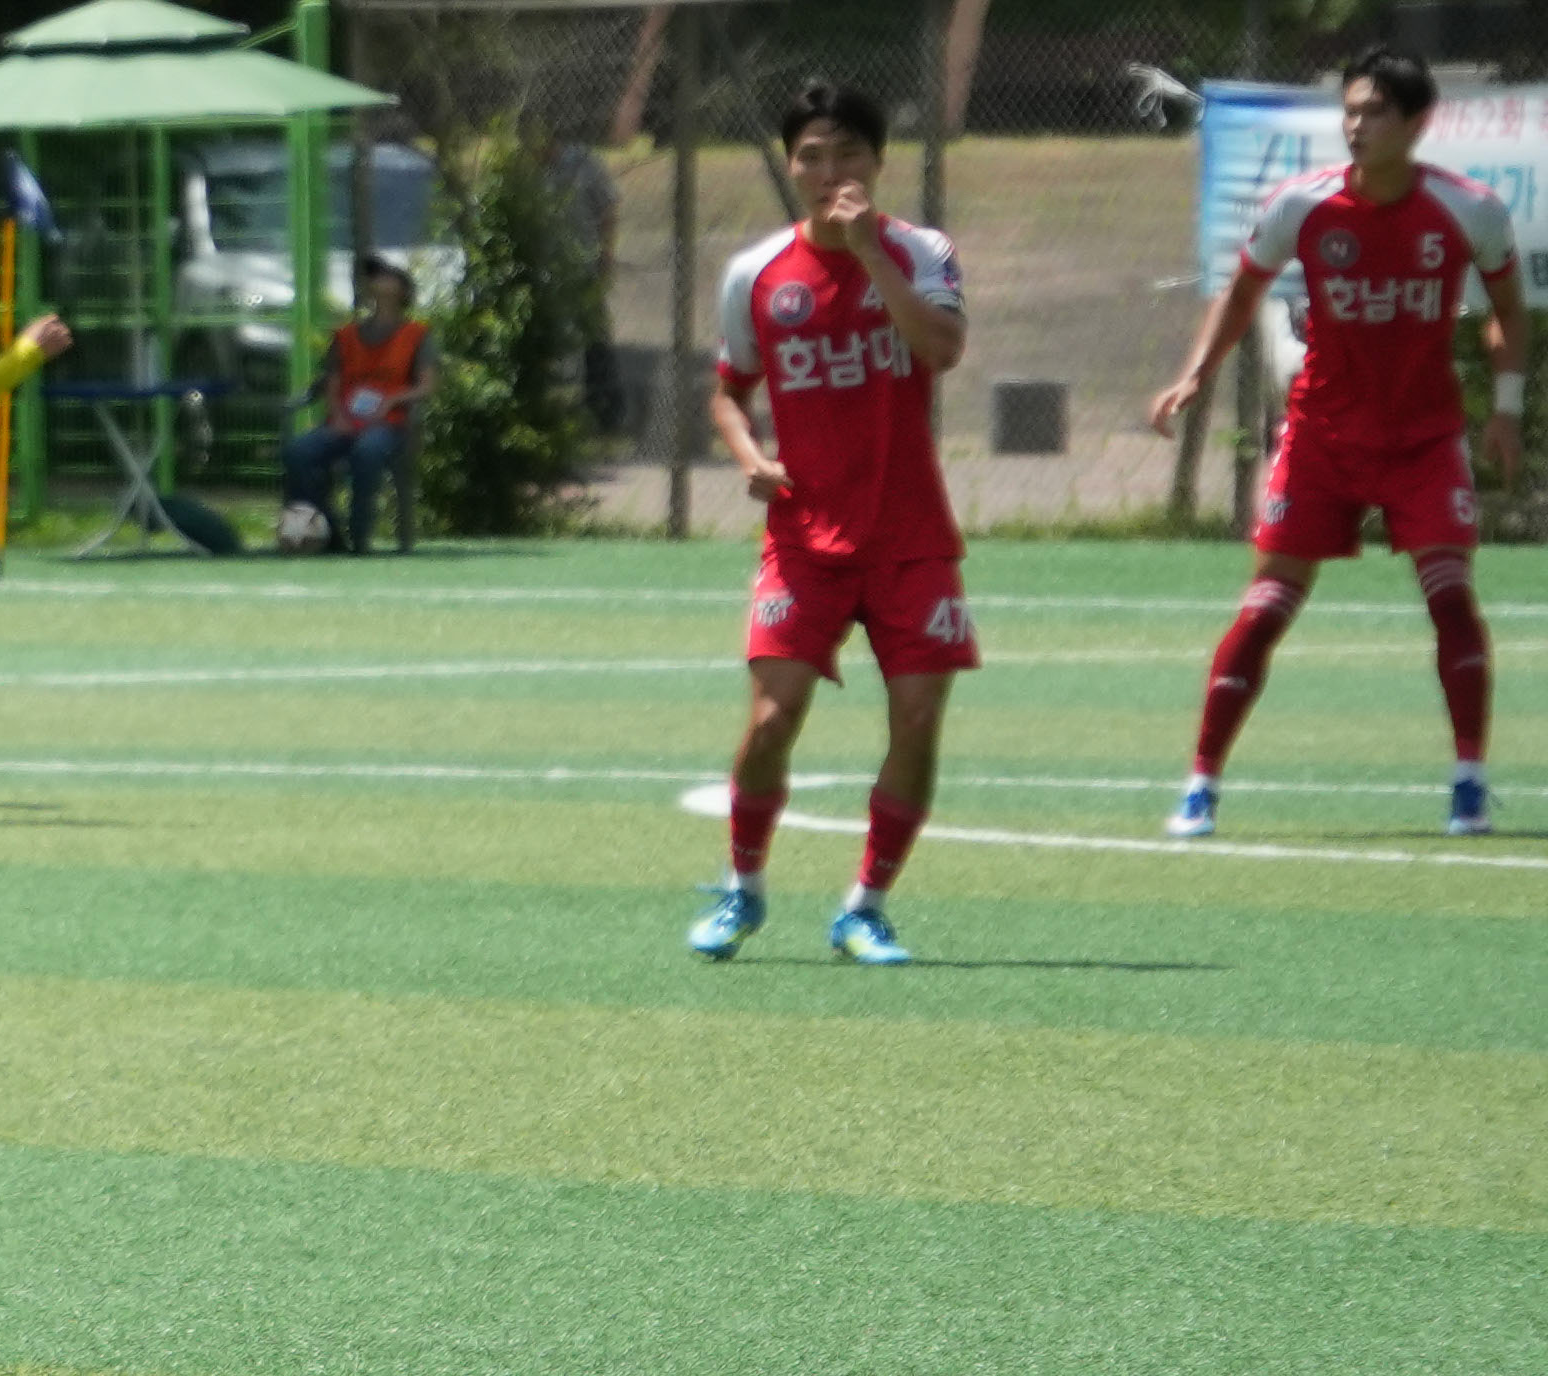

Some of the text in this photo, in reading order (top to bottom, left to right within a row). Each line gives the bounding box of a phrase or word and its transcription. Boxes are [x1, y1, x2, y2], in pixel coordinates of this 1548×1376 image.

[1421, 232, 1446, 270] 5
[861, 283, 885, 311] 4
[1323, 276, 1443, 322] 호남대
[777, 327, 913, 391] 호남대
[1453, 487, 1477, 525] 5
